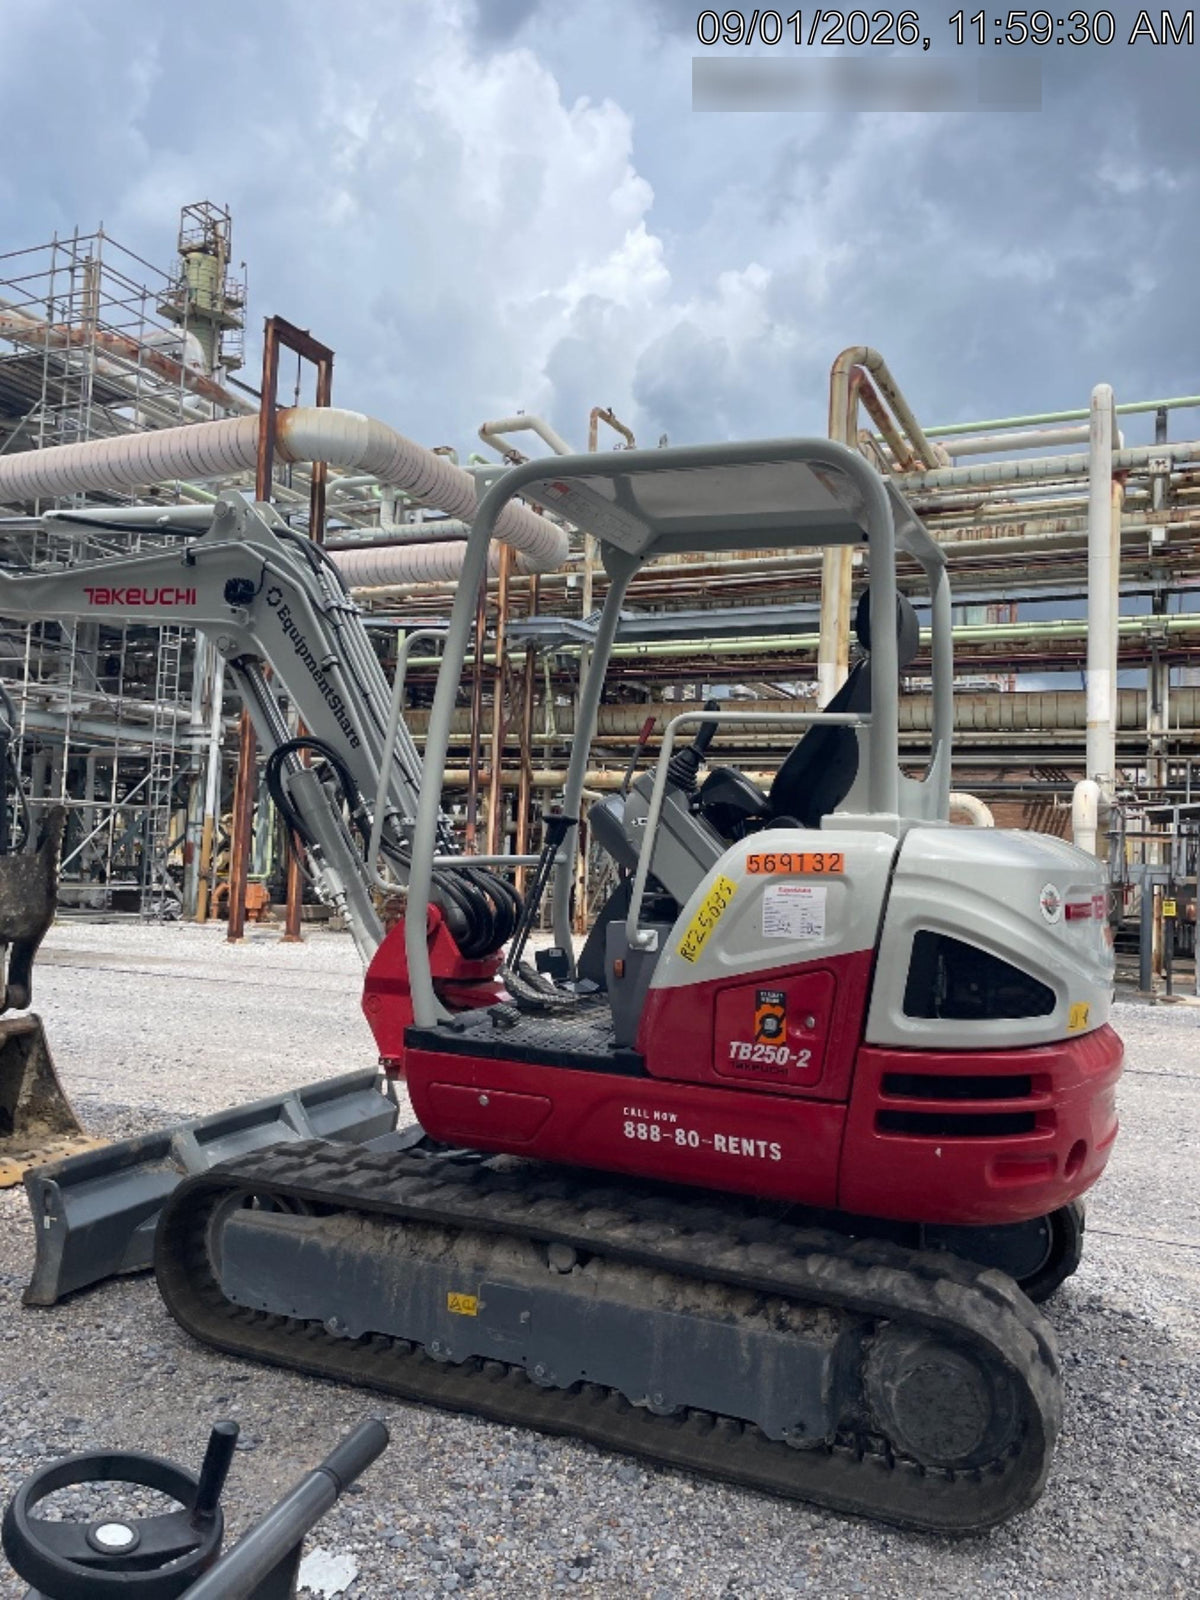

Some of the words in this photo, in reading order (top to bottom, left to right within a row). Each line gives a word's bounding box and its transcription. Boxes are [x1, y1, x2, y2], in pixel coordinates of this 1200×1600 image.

[83, 587, 197, 606] TAKEUCHI
[276, 603, 361, 750] EquipmentShare
[748, 852, 841, 873] 569132
[728, 1041, 812, 1068] TB250-2
[623, 1106, 650, 1119] CALL
[653, 1109, 679, 1123] NOW
[623, 1120, 783, 1162] 888-80-RENTS
